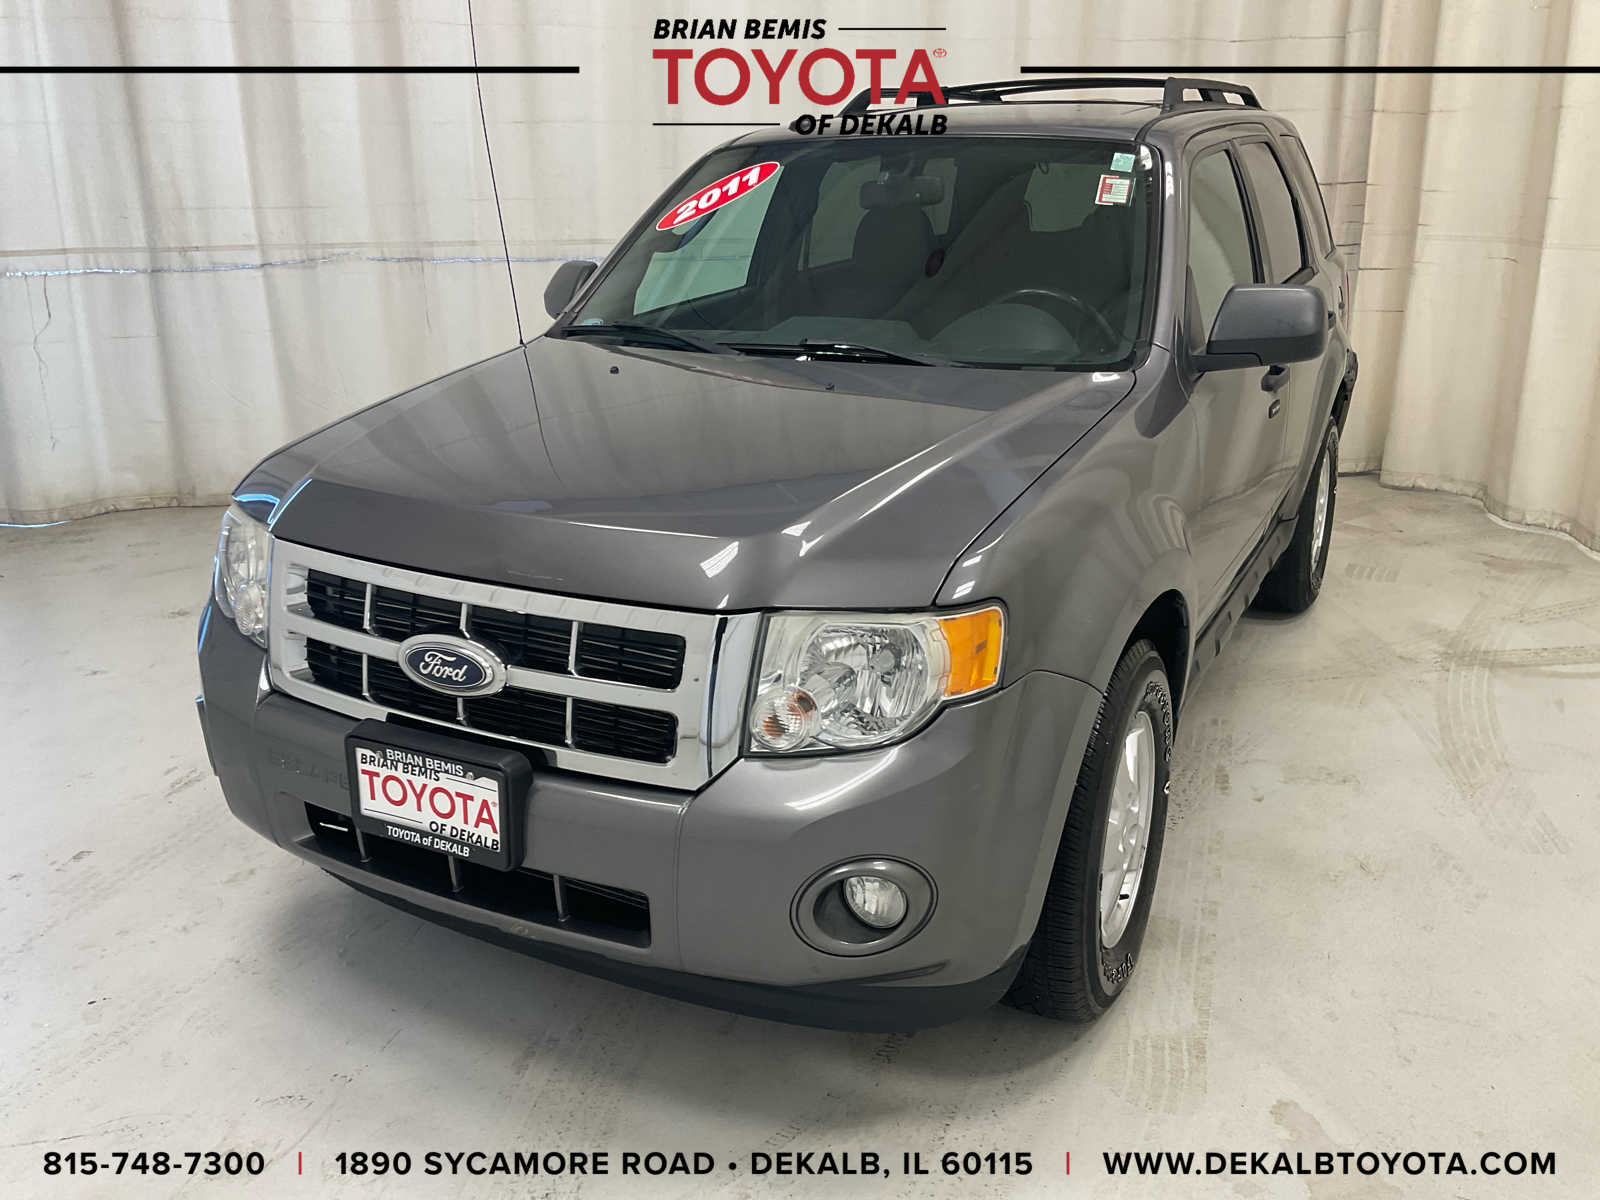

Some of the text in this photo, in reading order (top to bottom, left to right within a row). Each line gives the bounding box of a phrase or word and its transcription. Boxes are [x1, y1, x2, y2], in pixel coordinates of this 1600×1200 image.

[672, 166, 761, 225] 2011
[419, 651, 468, 682] Ford
[360, 753, 440, 782] BRIAN BEMIS
[386, 748, 464, 777] BRIAN BEMIS
[360, 768, 498, 835] TOYOTA
[386, 825, 470, 858] TOYOTA of DEKALB
[429, 821, 500, 851] OF DEKALB
